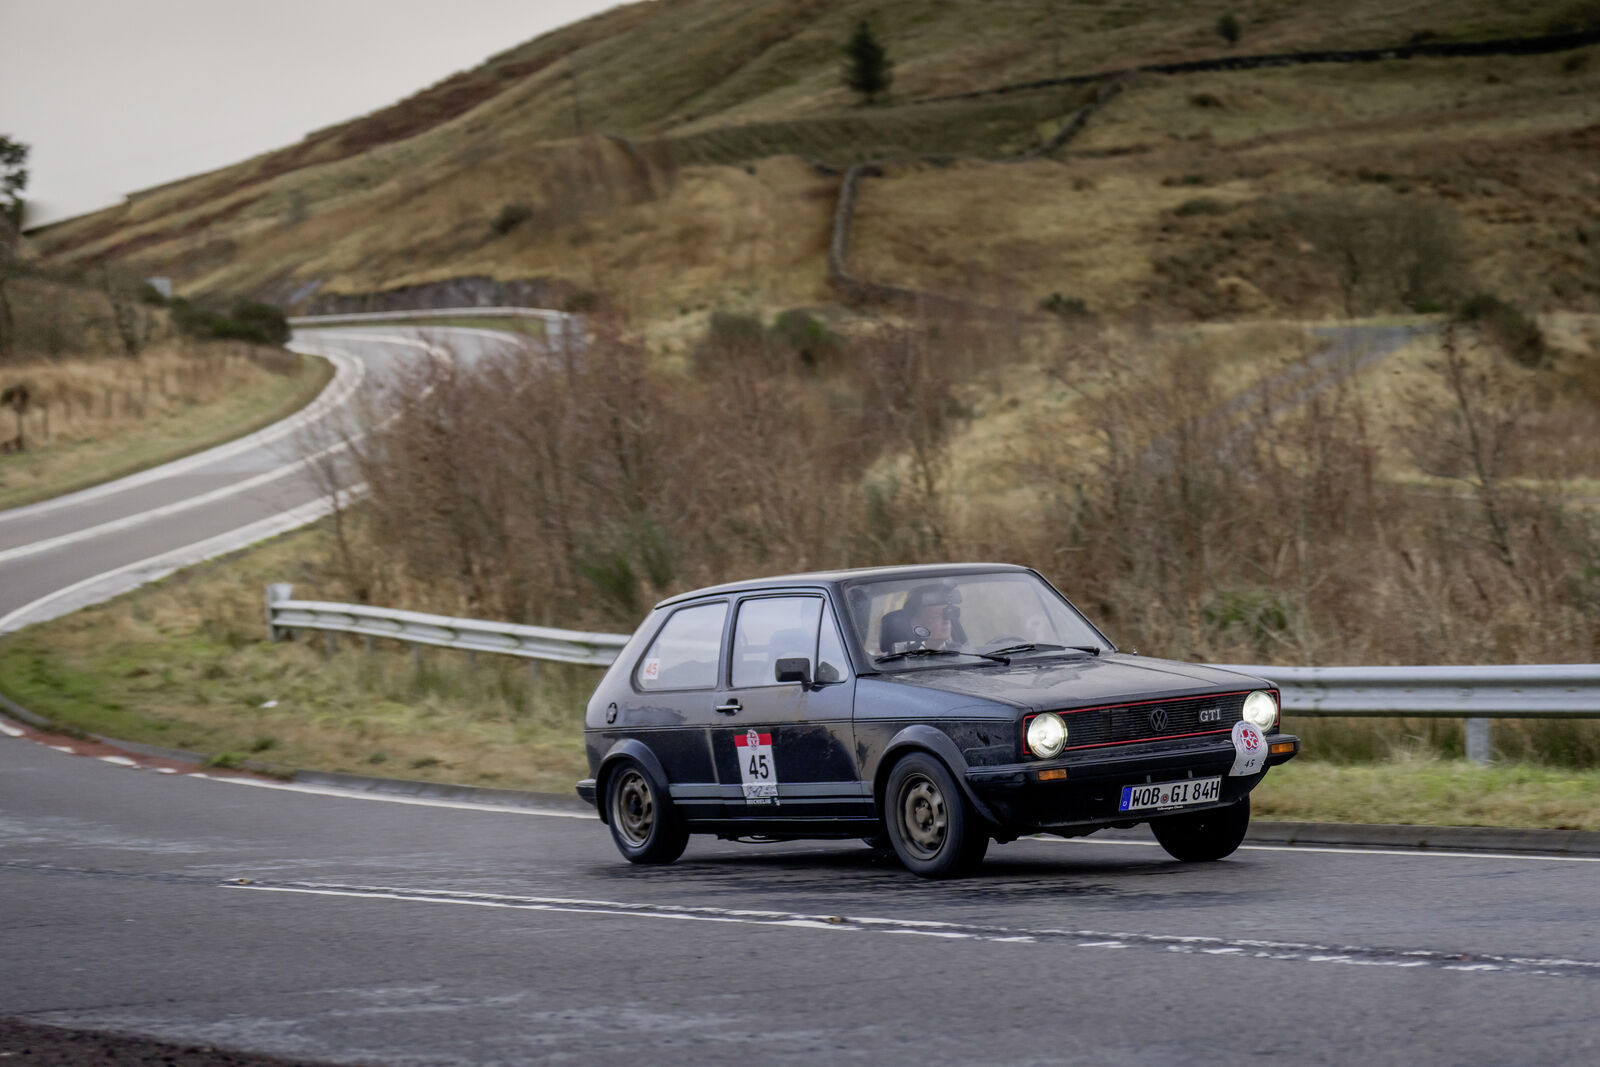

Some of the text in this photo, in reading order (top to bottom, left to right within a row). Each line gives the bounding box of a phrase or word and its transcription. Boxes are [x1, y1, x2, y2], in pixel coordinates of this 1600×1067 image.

[645, 663, 658, 675] 45
[1200, 708, 1221, 722] GTI
[749, 754, 769, 779] 45
[1244, 759, 1256, 768] 45
[1131, 780, 1220, 807] WOB GI 84H
